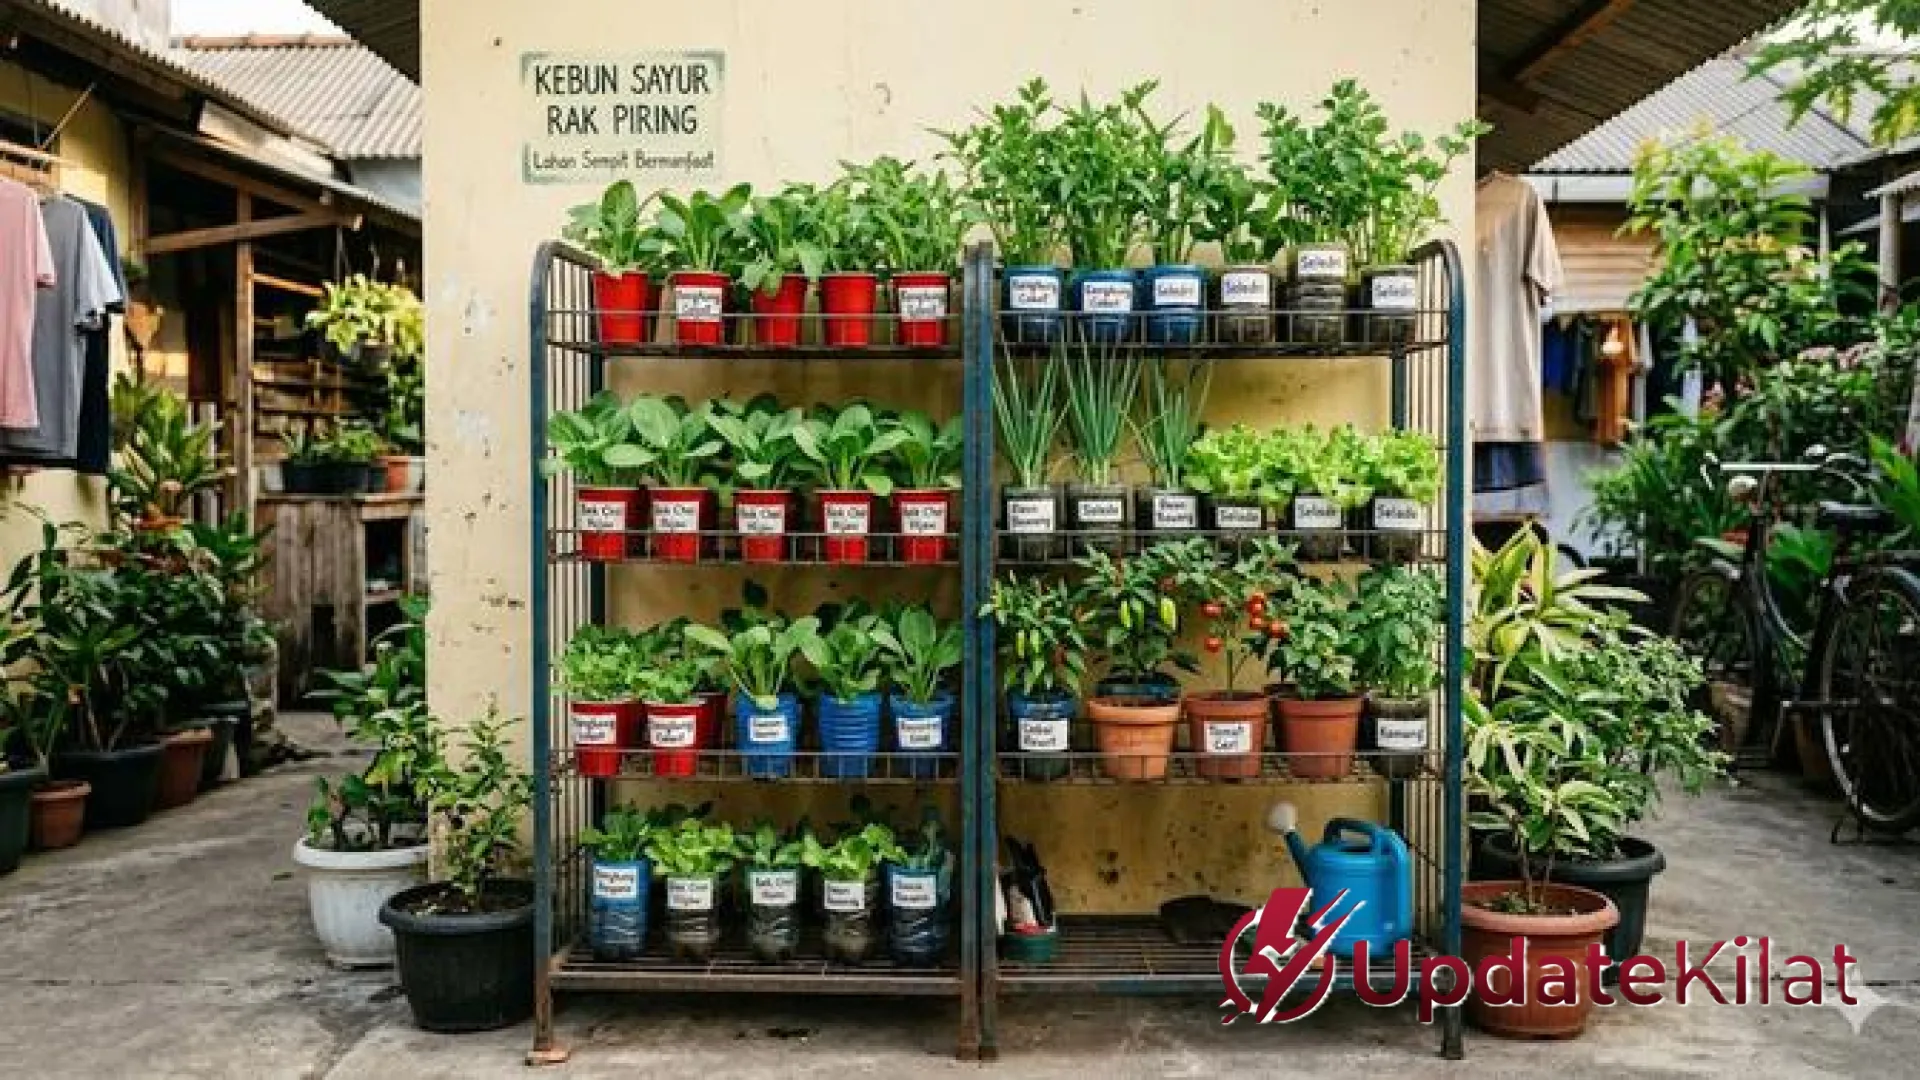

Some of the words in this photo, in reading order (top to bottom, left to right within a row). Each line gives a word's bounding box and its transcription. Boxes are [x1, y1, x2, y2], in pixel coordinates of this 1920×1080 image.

[536, 64, 618, 94] KEBUN
[631, 64, 710, 94] SAYUR
[547, 105, 599, 134] RAK
[613, 105, 697, 134] PIRING
[533, 151, 576, 169] Lahan
[582, 149, 628, 172] Sempit
